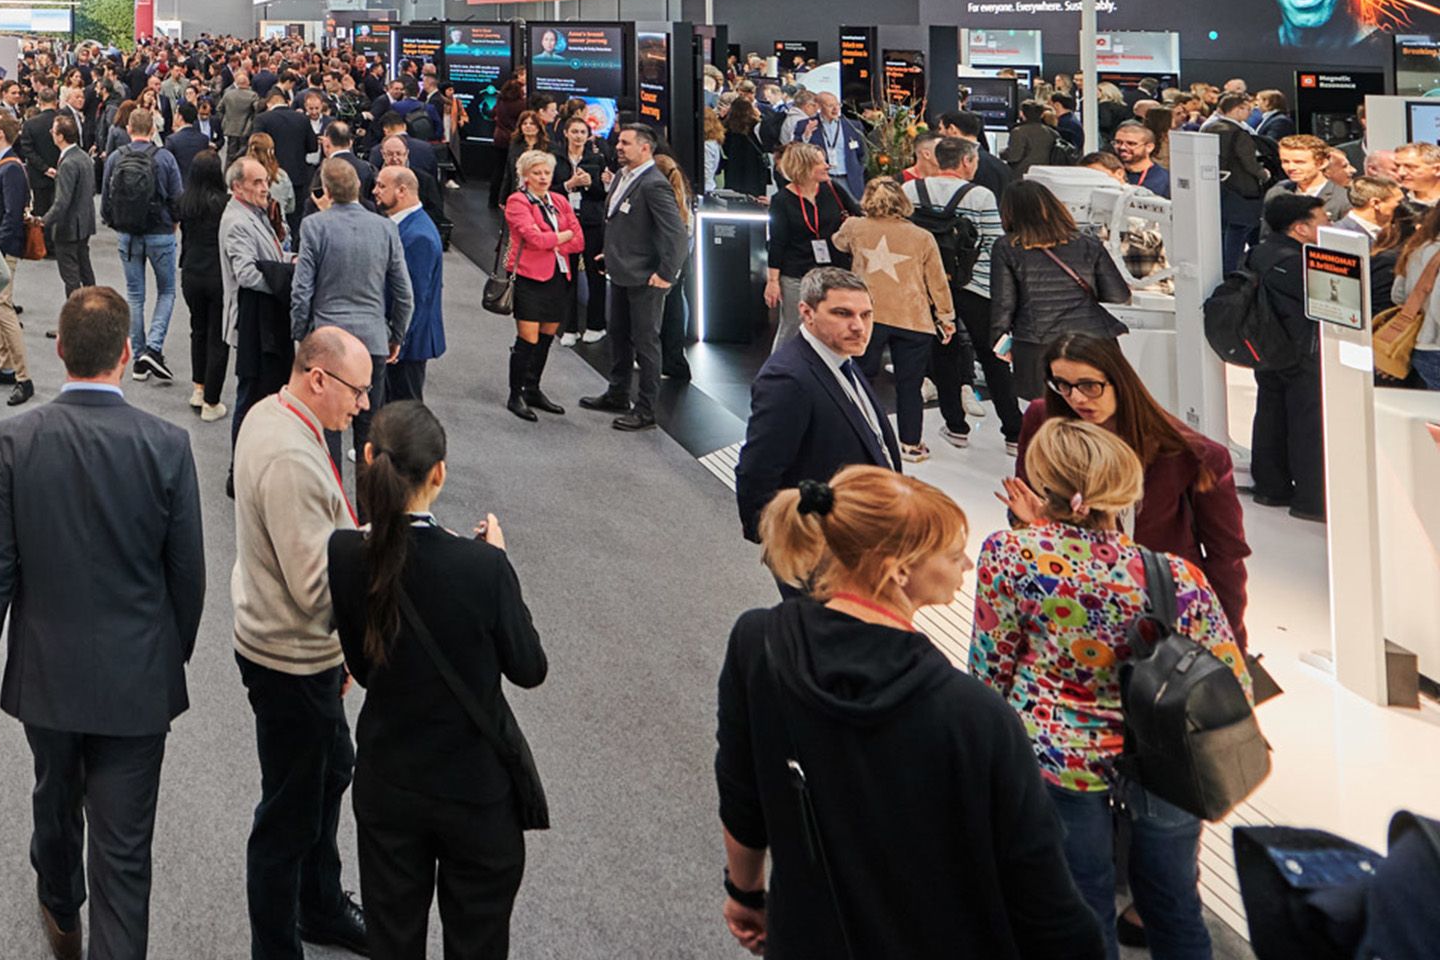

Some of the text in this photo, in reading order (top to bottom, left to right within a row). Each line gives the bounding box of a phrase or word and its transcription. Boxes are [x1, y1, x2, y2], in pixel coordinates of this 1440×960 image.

[967, 0, 1117, 15] For everyone. Everywhere. Sustably.
[1319, 75, 1351, 83] Magnetic
[1308, 250, 1357, 268] MAMMOMAT
